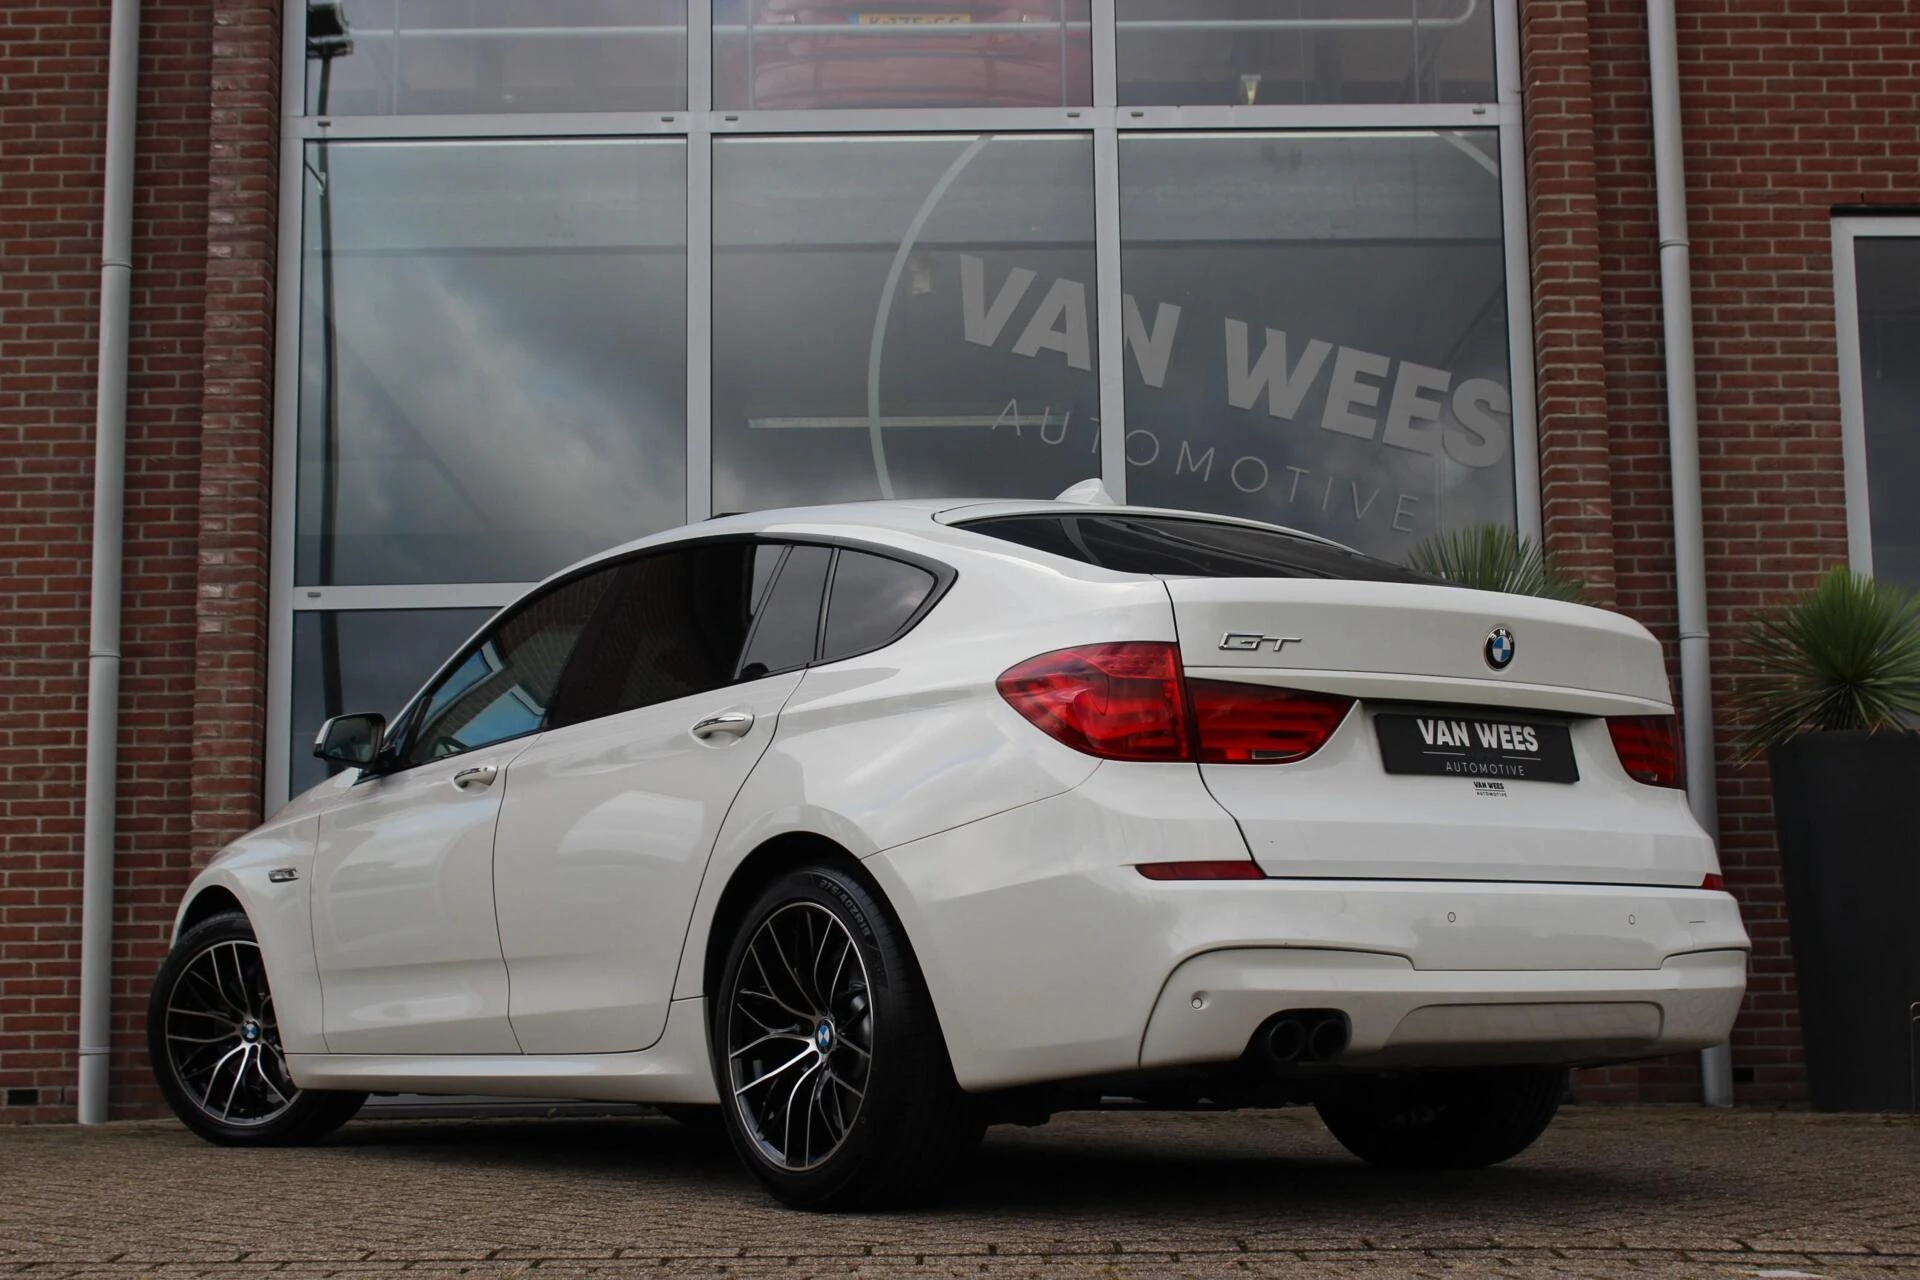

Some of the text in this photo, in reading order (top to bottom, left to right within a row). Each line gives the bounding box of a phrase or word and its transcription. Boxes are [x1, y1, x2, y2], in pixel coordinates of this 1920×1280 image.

[960, 254, 1510, 467] VAN WEES
[991, 398, 1419, 534] AUTOMOTIVE
[1218, 632, 1303, 652] GT
[1416, 718, 1539, 752] VAN WEES
[1445, 761, 1525, 776] AUTOMOTIVE
